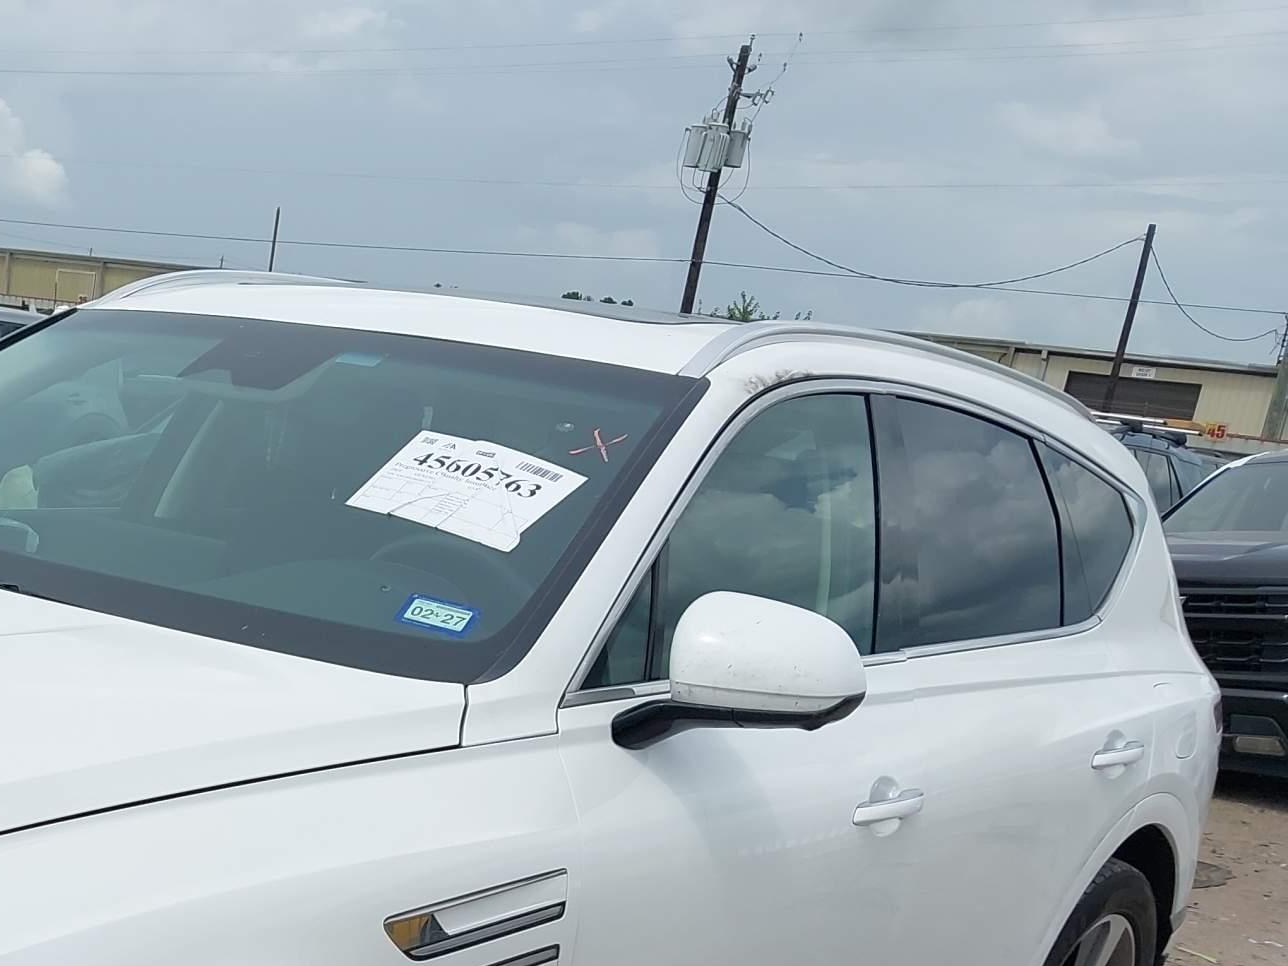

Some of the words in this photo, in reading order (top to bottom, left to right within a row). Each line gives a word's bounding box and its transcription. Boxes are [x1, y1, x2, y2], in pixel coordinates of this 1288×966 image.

[413, 452, 542, 498] 45605763
[410, 606, 434, 620] 02
[439, 613, 467, 627] 27
